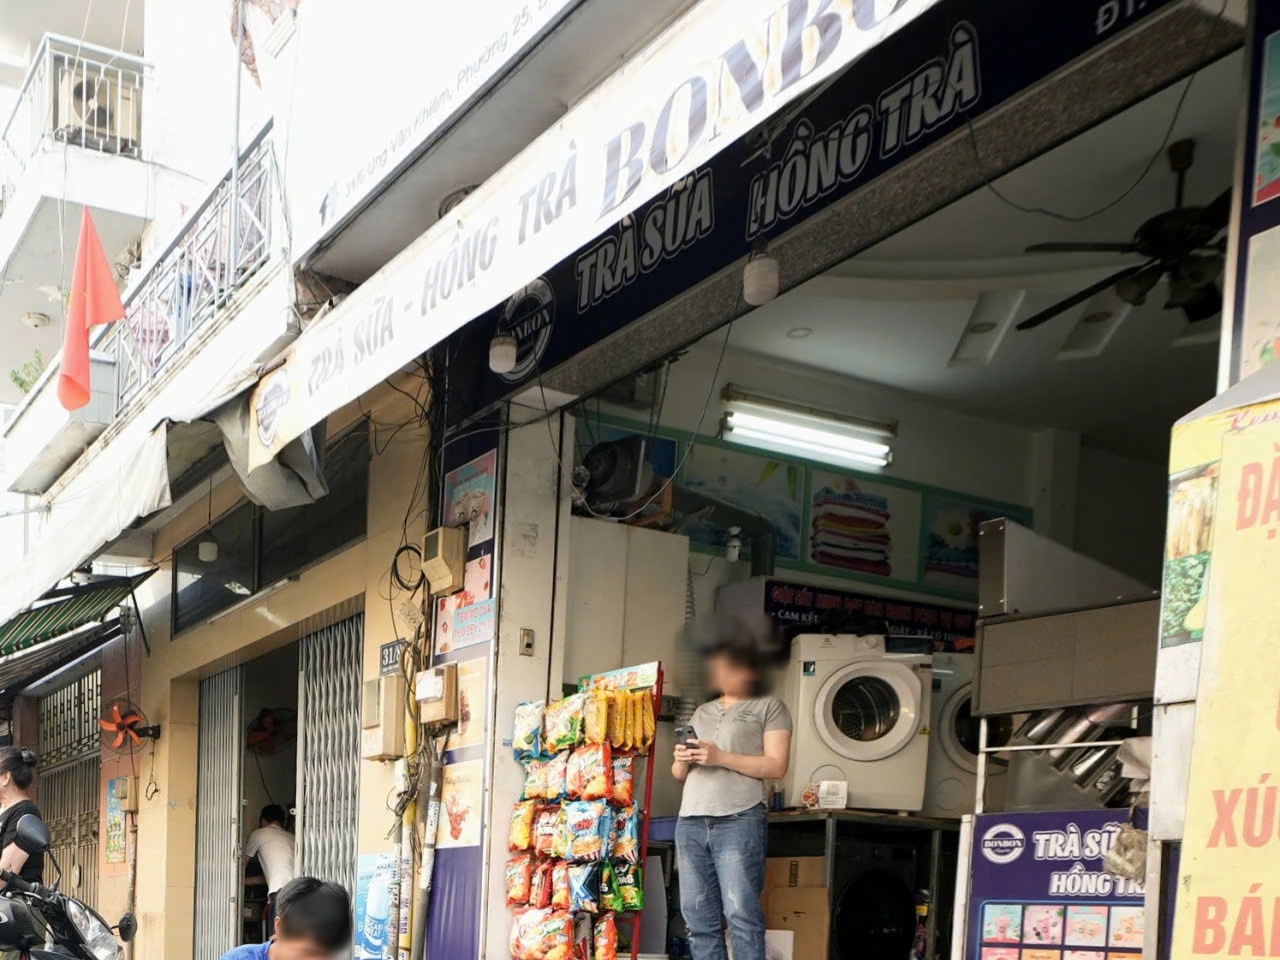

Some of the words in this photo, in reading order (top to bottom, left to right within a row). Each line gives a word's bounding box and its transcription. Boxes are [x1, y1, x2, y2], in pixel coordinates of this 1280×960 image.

[576, 212, 637, 314] TRÀ
[638, 167, 715, 274] SỮA
[745, 117, 873, 241] HỒNG
[876, 20, 982, 162] TRÀ
[353, 294, 395, 366] SỮA
[420, 214, 500, 317] HỒNG
[518, 138, 577, 245] TRÀ
[777, 609, 800, 622] CAM
[1033, 822, 1081, 861] TRÀ
[1084, 821, 1123, 860] SỮ
[1206, 772, 1280, 849] XÚ
[1049, 862, 1112, 896] HỒNG
[1192, 882, 1280, 957] BÁ
